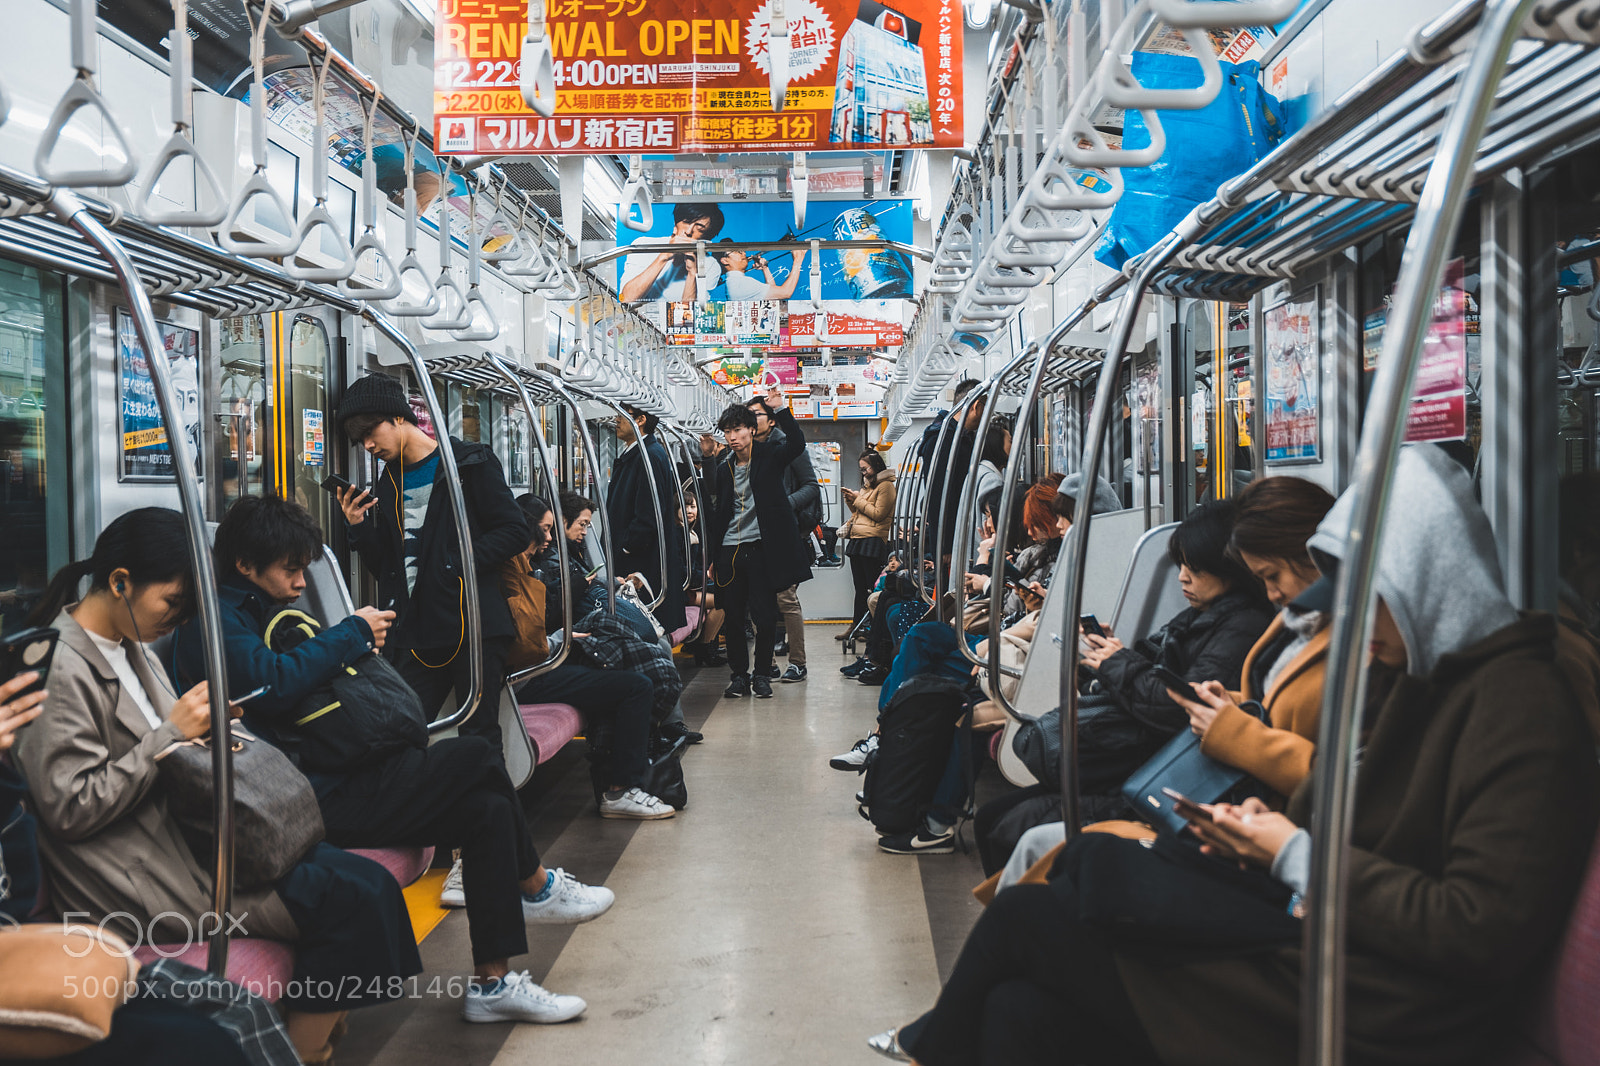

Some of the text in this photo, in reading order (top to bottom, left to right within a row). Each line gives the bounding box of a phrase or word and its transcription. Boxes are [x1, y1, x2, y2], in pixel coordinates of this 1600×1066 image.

[639, 19, 740, 56] OPEN
[485, 118, 675, 150] マルハン新宿店
[731, 116, 813, 139] 徒歩1分
[750, 302, 759, 333] 上田秀人
[878, 332, 902, 340] Keio
